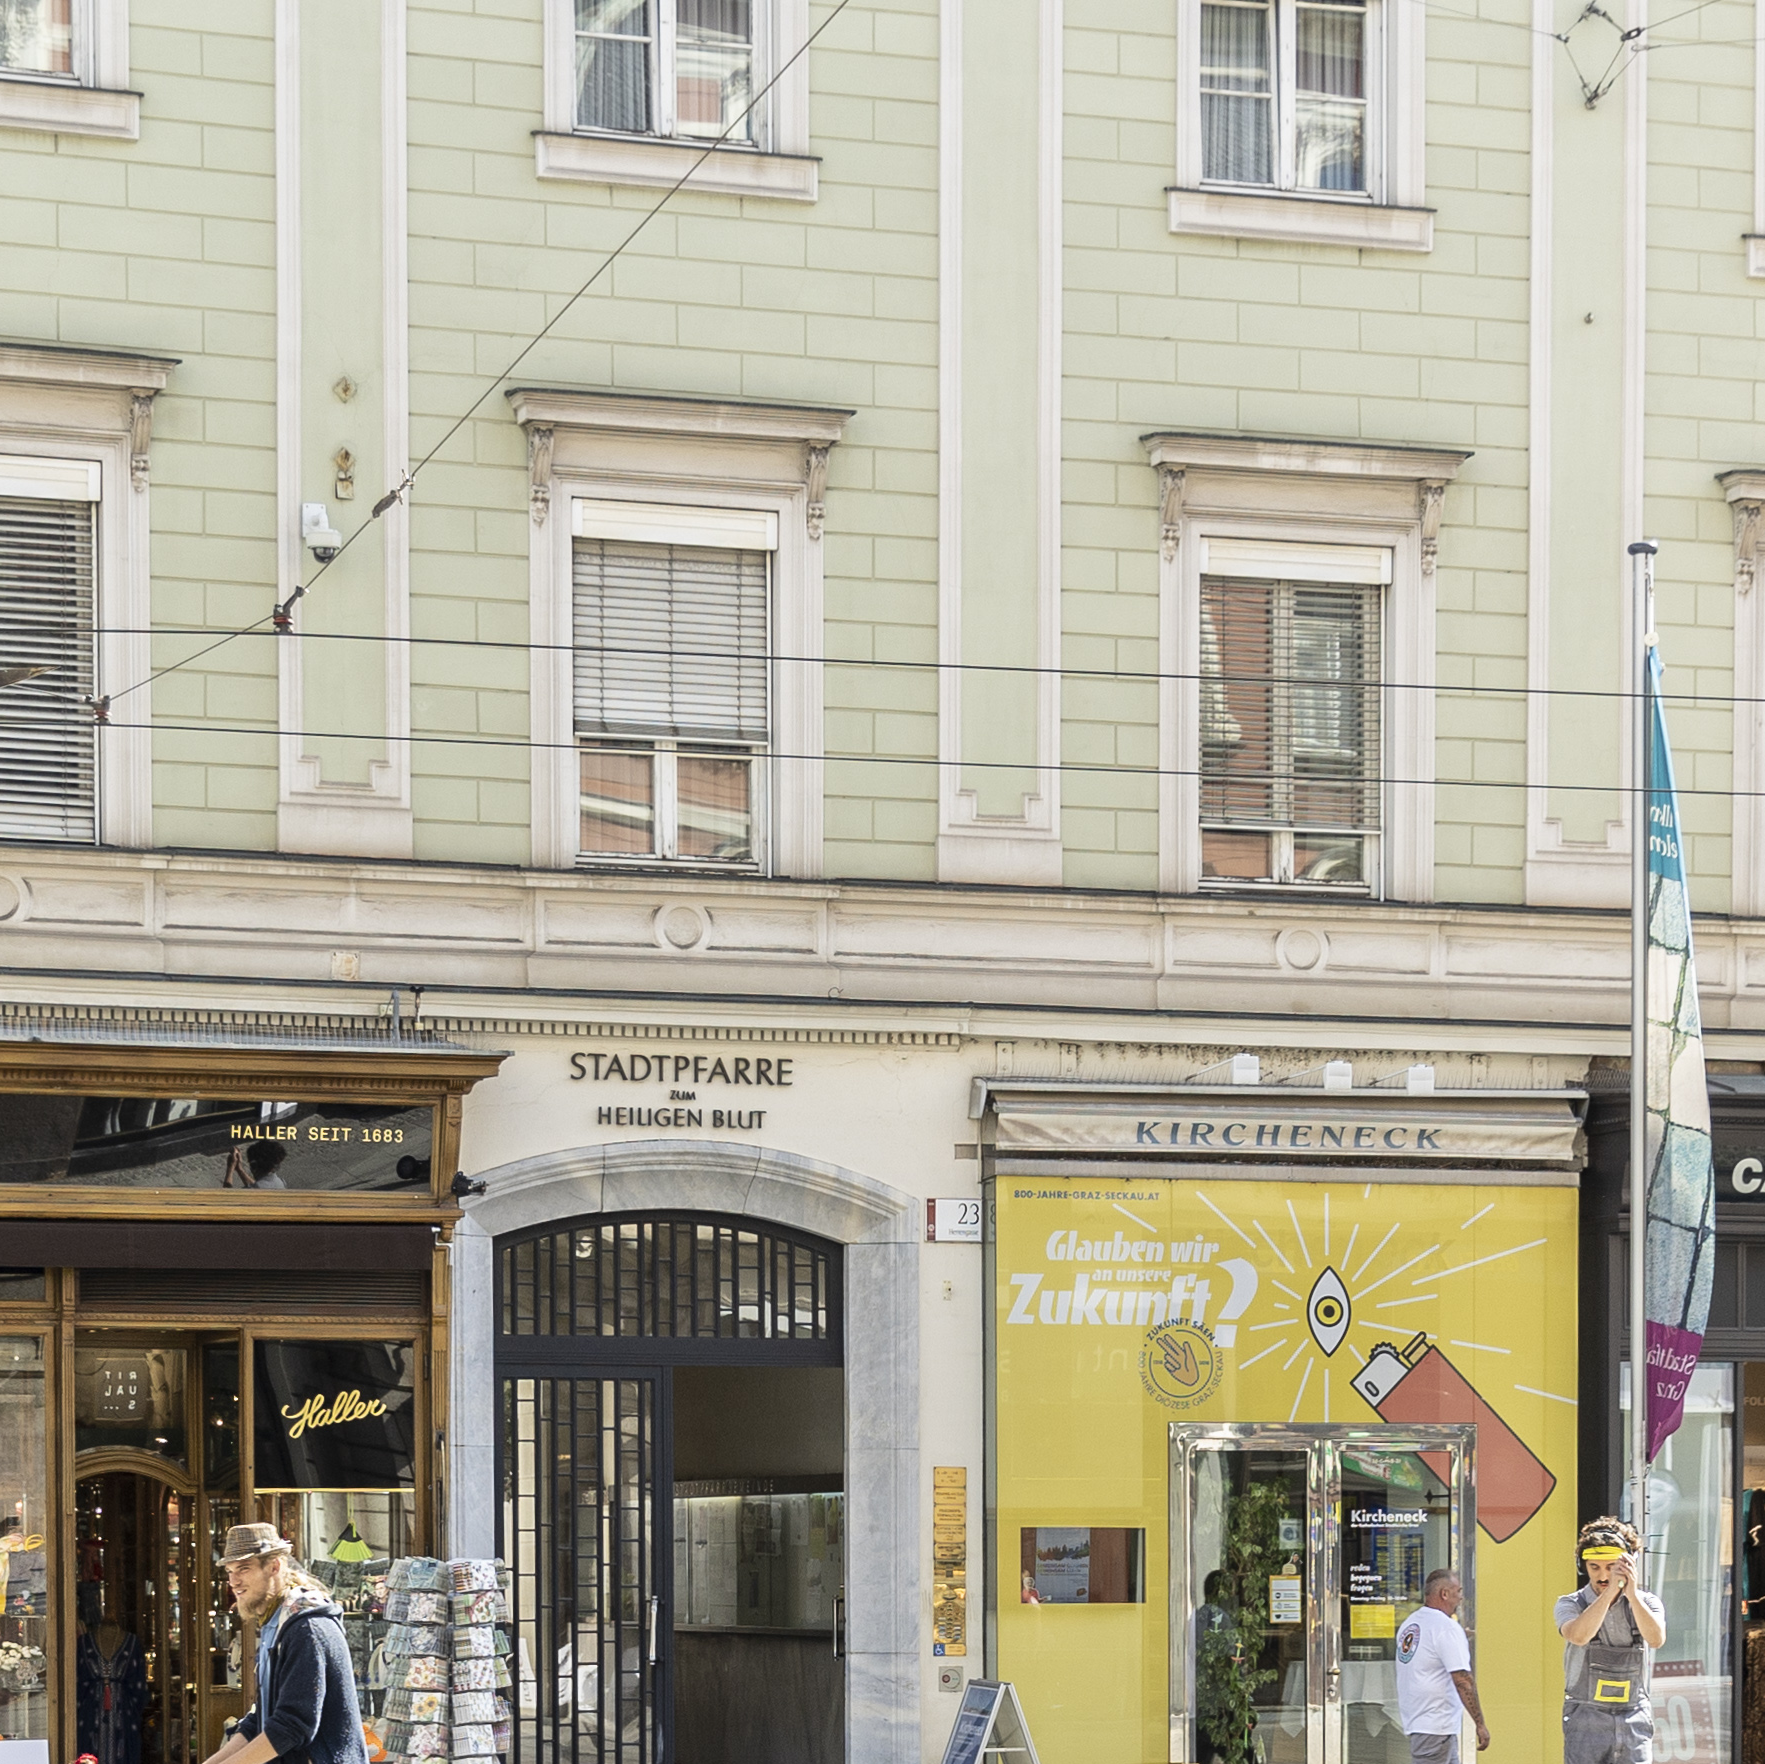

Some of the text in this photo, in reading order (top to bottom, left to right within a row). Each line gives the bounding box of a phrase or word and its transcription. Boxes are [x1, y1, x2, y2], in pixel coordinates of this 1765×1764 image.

[570, 1053, 793, 1085] STADTPFARRE
[598, 1106, 767, 1129] HEILIGEN BLUT
[231, 1125, 403, 1143] HALLER SEIT 1683
[1136, 1120, 1443, 1150] KIRCHENECK
[1014, 1189, 1160, 1201] 800-JAHRE-GRAZ-SECKAU.AT
[958, 1203, 979, 1225] 23
[1046, 1230, 1220, 1263] Glauben wir
[1092, 1269, 1171, 1282] an unsere
[1006, 1257, 1258, 1348] Zukunft?
[1146, 1318, 1190, 1341] ZUKUNFT
[281, 1390, 386, 1438] Haller
[1351, 1509, 1428, 1523] Kircheneck
